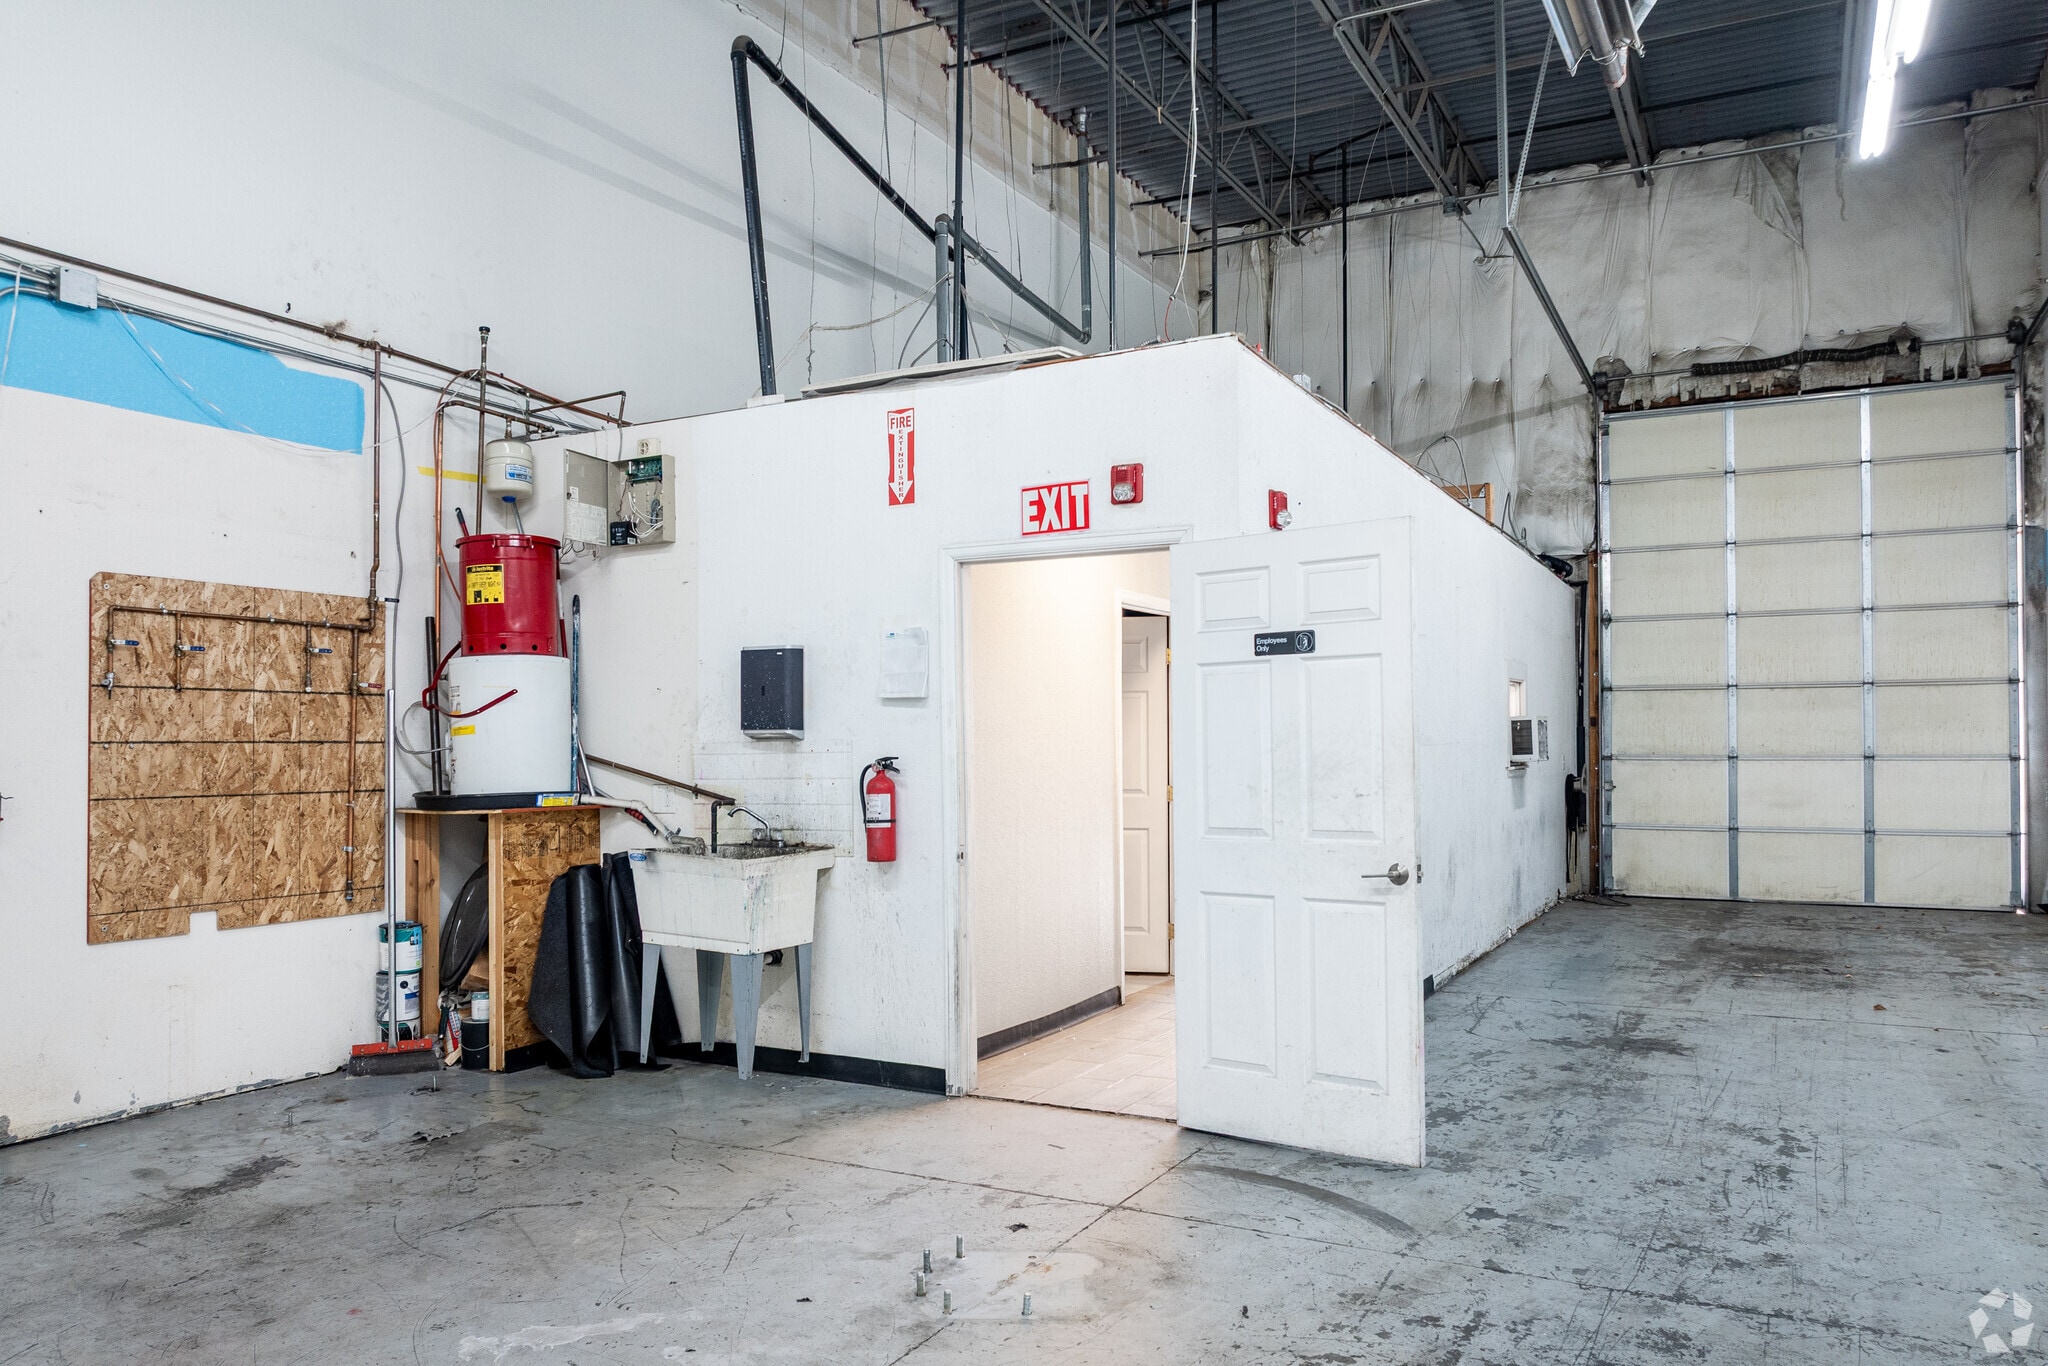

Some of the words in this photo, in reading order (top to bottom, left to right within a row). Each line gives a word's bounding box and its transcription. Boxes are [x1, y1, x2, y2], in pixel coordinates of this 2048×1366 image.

[890, 415, 911, 429] FIRE
[1022, 483, 1088, 533] EXIT
[1256, 637, 1287, 645] Employees
